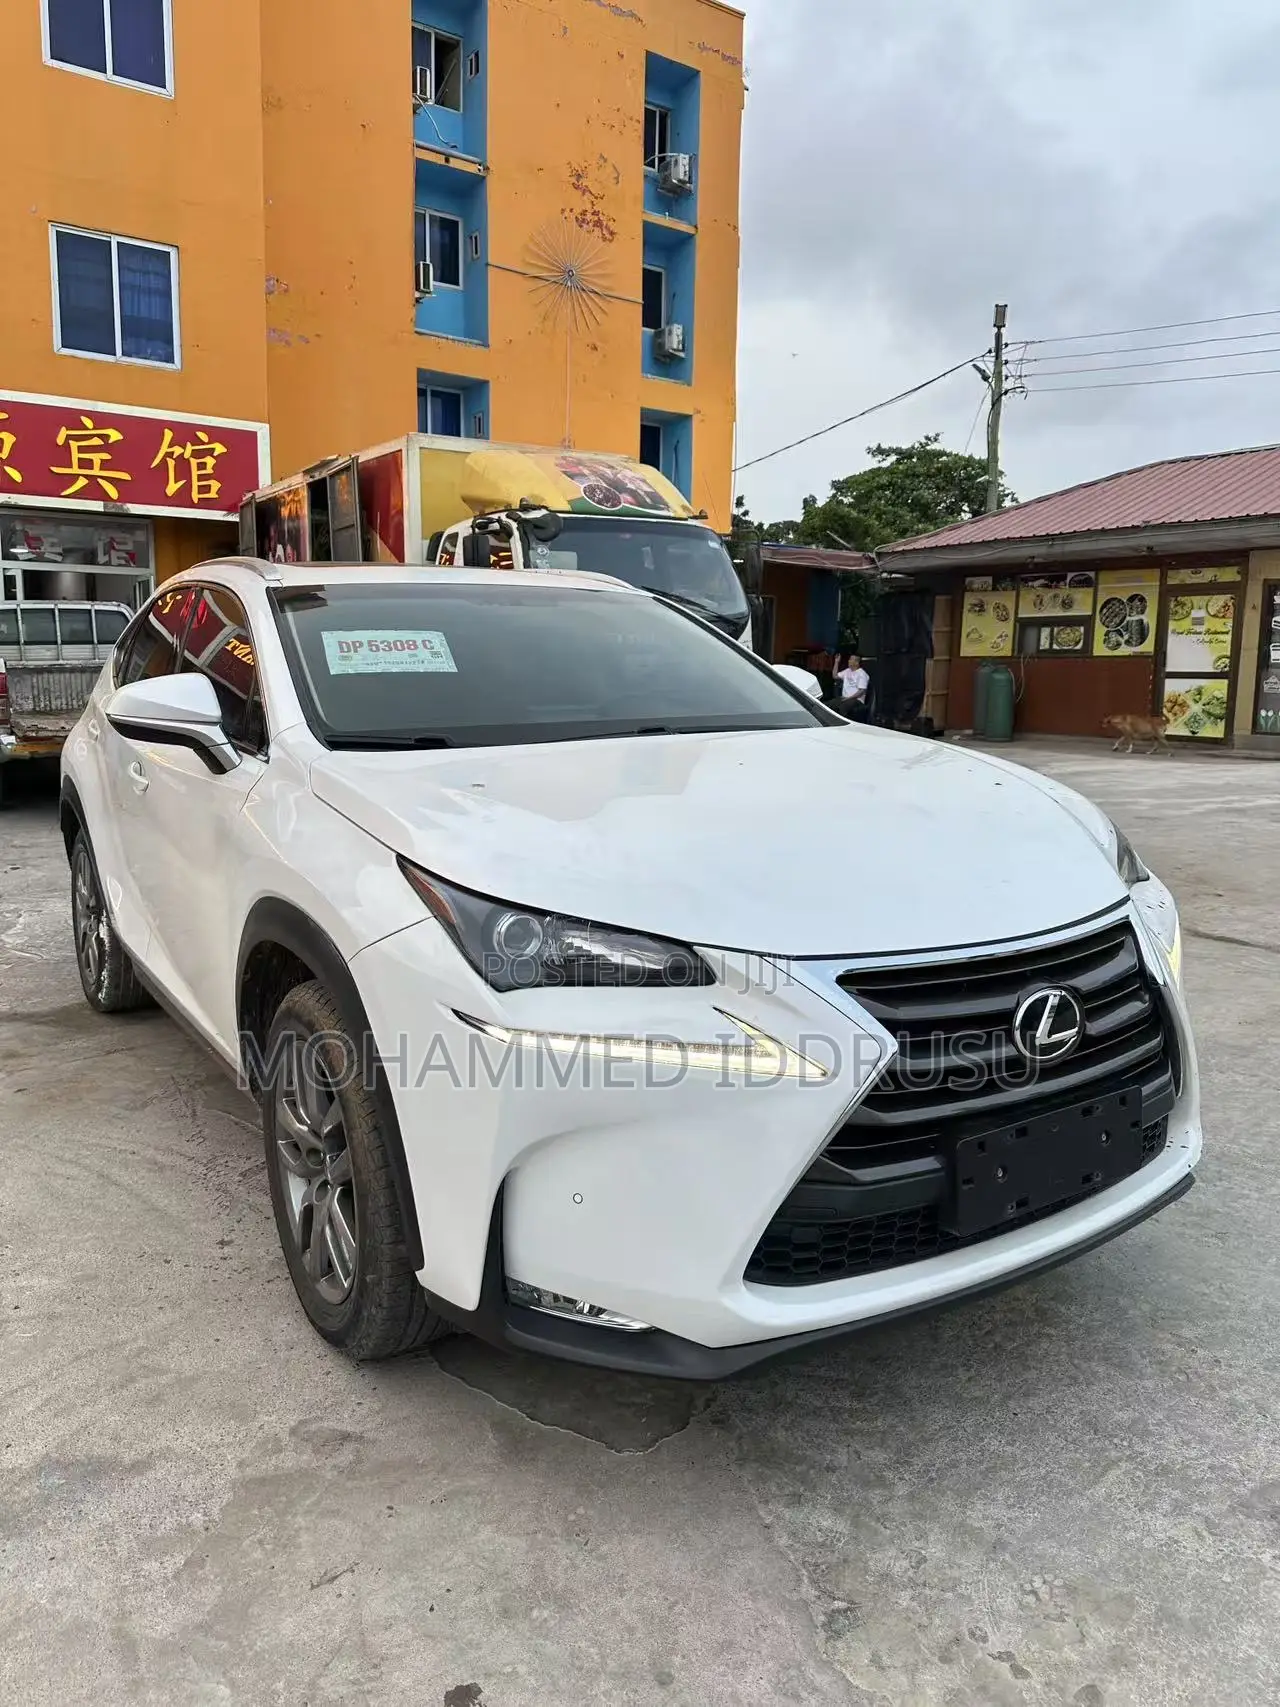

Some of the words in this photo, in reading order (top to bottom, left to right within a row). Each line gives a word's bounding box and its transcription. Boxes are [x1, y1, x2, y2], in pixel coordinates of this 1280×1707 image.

[337, 640, 363, 653] DP
[367, 639, 418, 652] 5308
[422, 639, 435, 650] C
